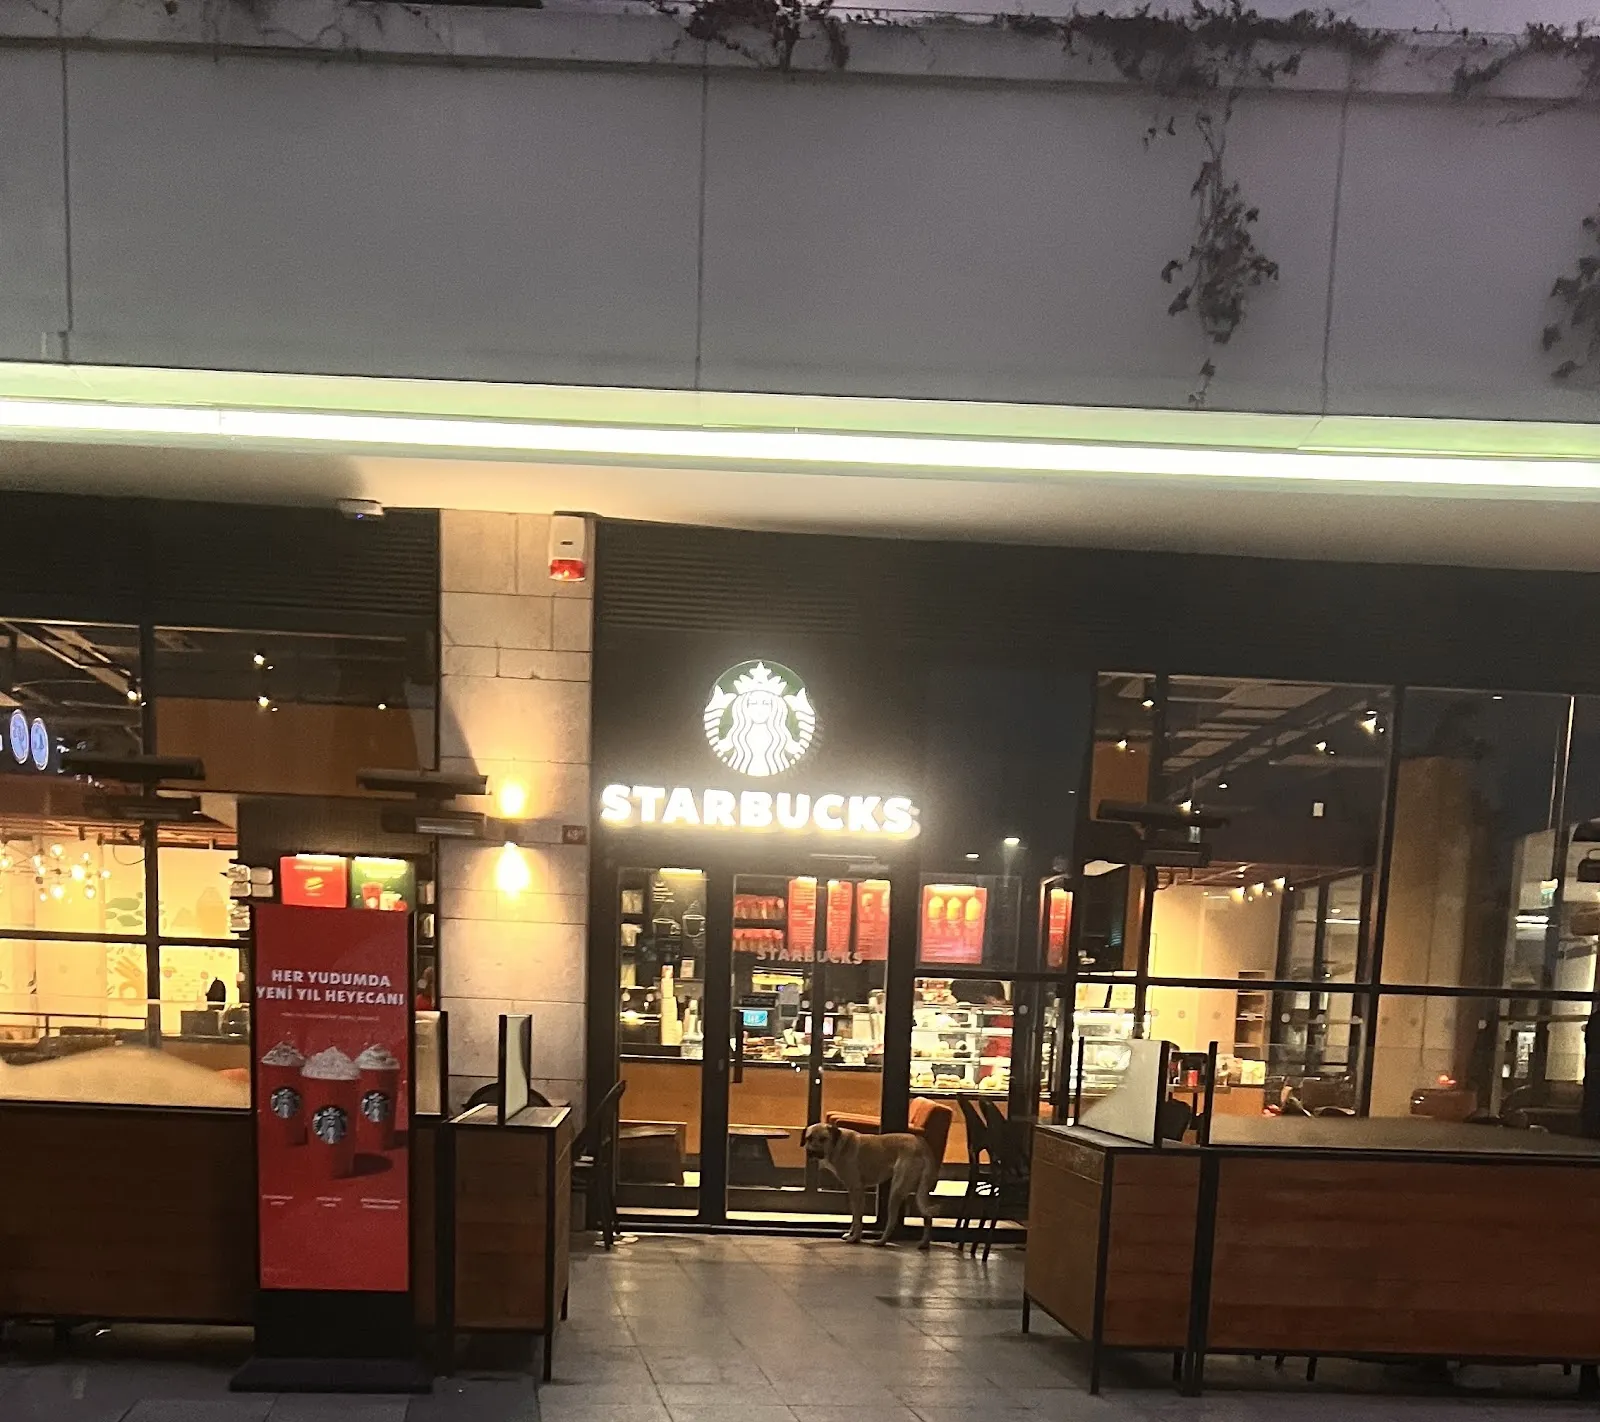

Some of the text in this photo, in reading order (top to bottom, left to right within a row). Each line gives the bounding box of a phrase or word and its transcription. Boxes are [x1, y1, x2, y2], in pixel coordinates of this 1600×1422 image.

[600, 784, 914, 834] STARBUCKS
[756, 949, 863, 965] STARBUCKS
[271, 969, 391, 987] HER YUDUMDA
[256, 985, 404, 1005] YENİ YIL HEYECANI
